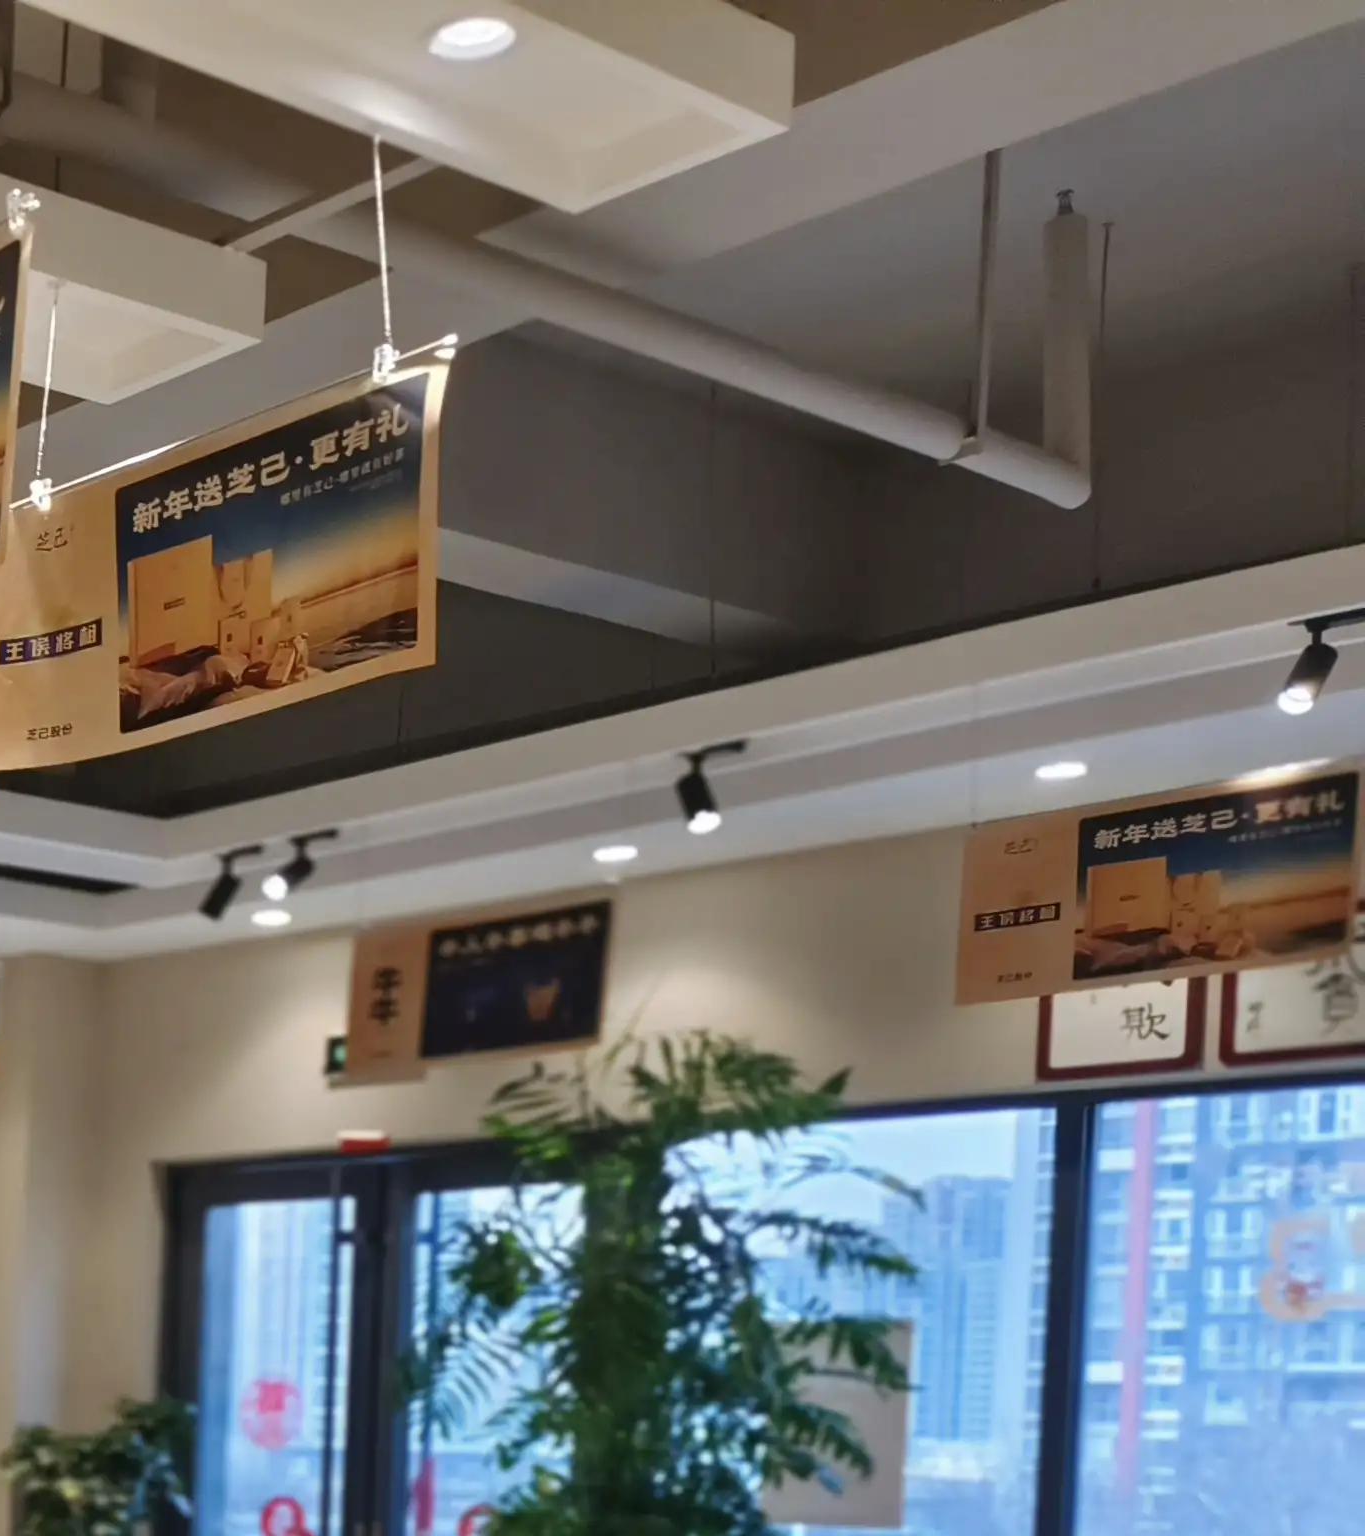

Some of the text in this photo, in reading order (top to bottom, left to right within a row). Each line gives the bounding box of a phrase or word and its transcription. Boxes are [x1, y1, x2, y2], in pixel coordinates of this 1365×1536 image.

[132, 403, 410, 534] 新年送芝己·更有礼
